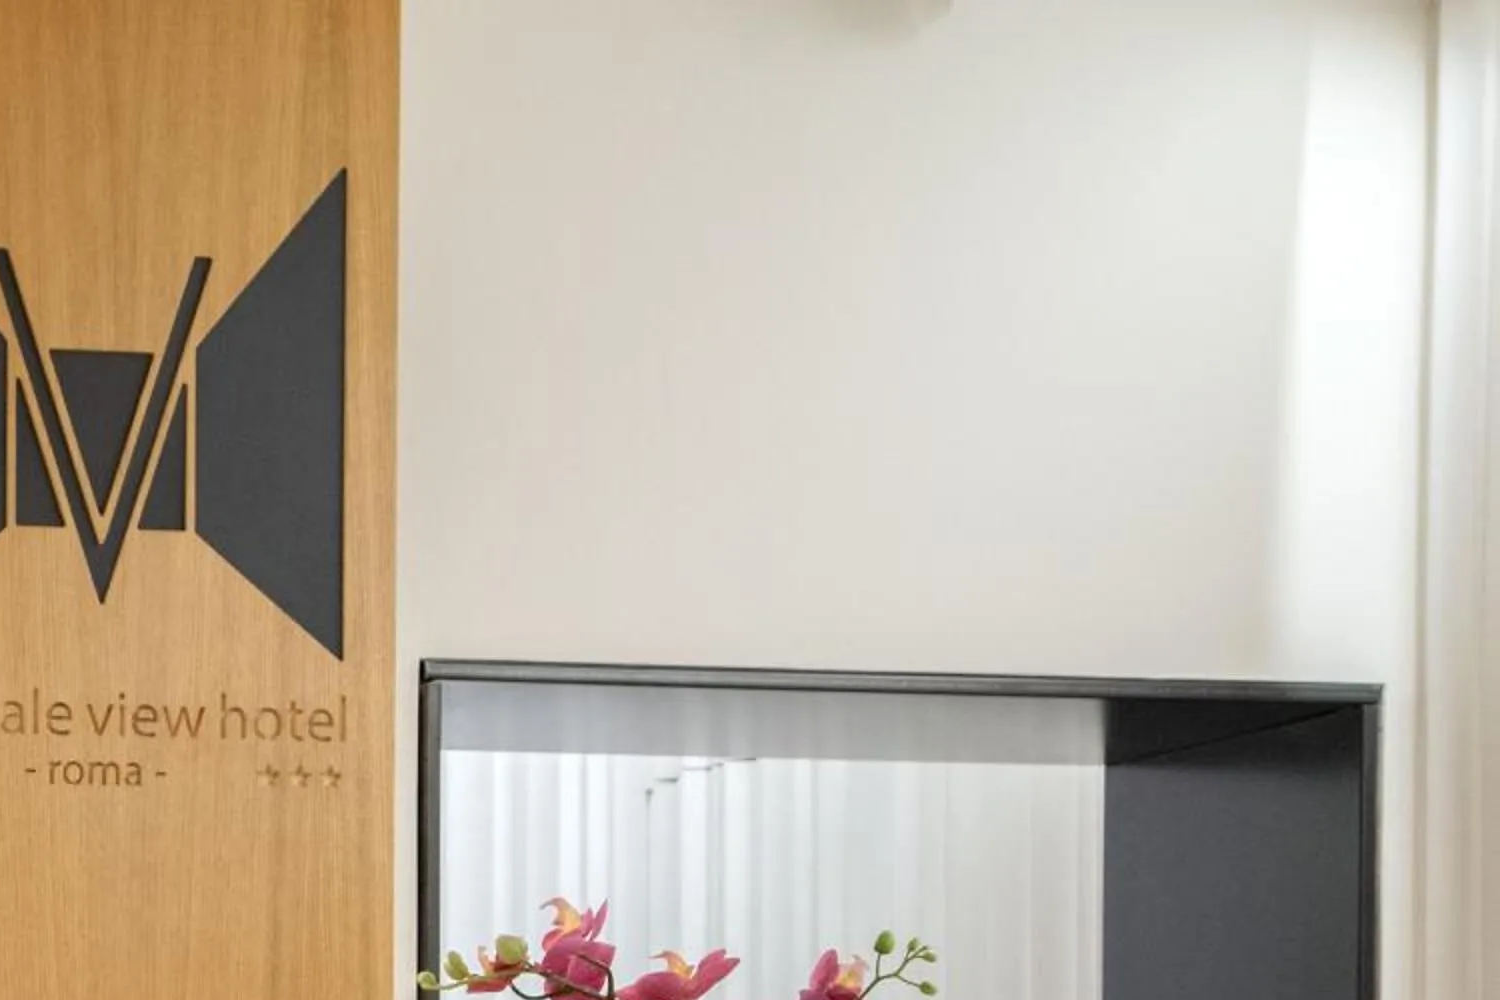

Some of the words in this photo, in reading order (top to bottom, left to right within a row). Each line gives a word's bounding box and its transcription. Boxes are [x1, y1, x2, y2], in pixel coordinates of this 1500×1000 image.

[86, 691, 206, 738] view
[219, 691, 347, 743] hotel
[48, 758, 142, 787] roma
